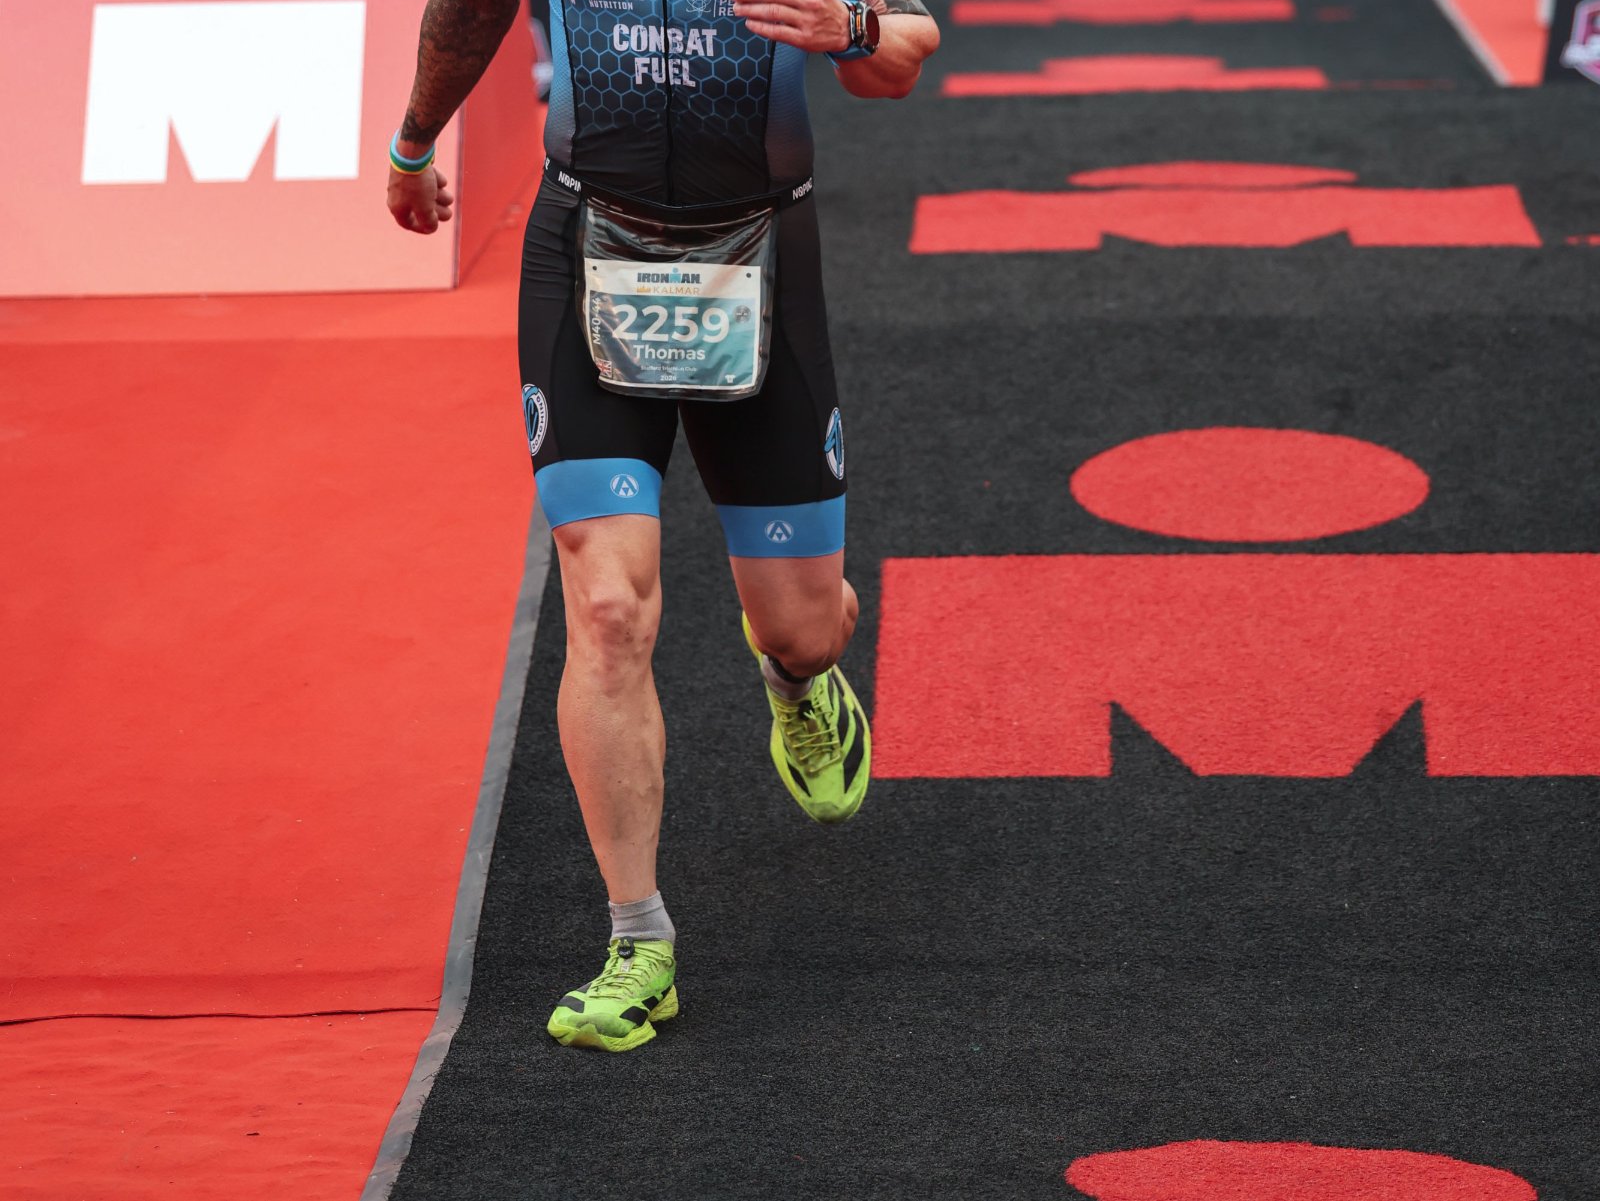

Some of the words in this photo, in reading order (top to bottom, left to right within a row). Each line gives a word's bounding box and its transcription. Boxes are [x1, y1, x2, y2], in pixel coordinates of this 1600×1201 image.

[588, 0, 634, 11] NUTRITION
[612, 23, 718, 57] COMBAT
[634, 57, 696, 88] FUEL
[652, 286, 700, 295] KALMAR
[611, 304, 730, 344] 2259
[633, 345, 706, 361] Thomas
